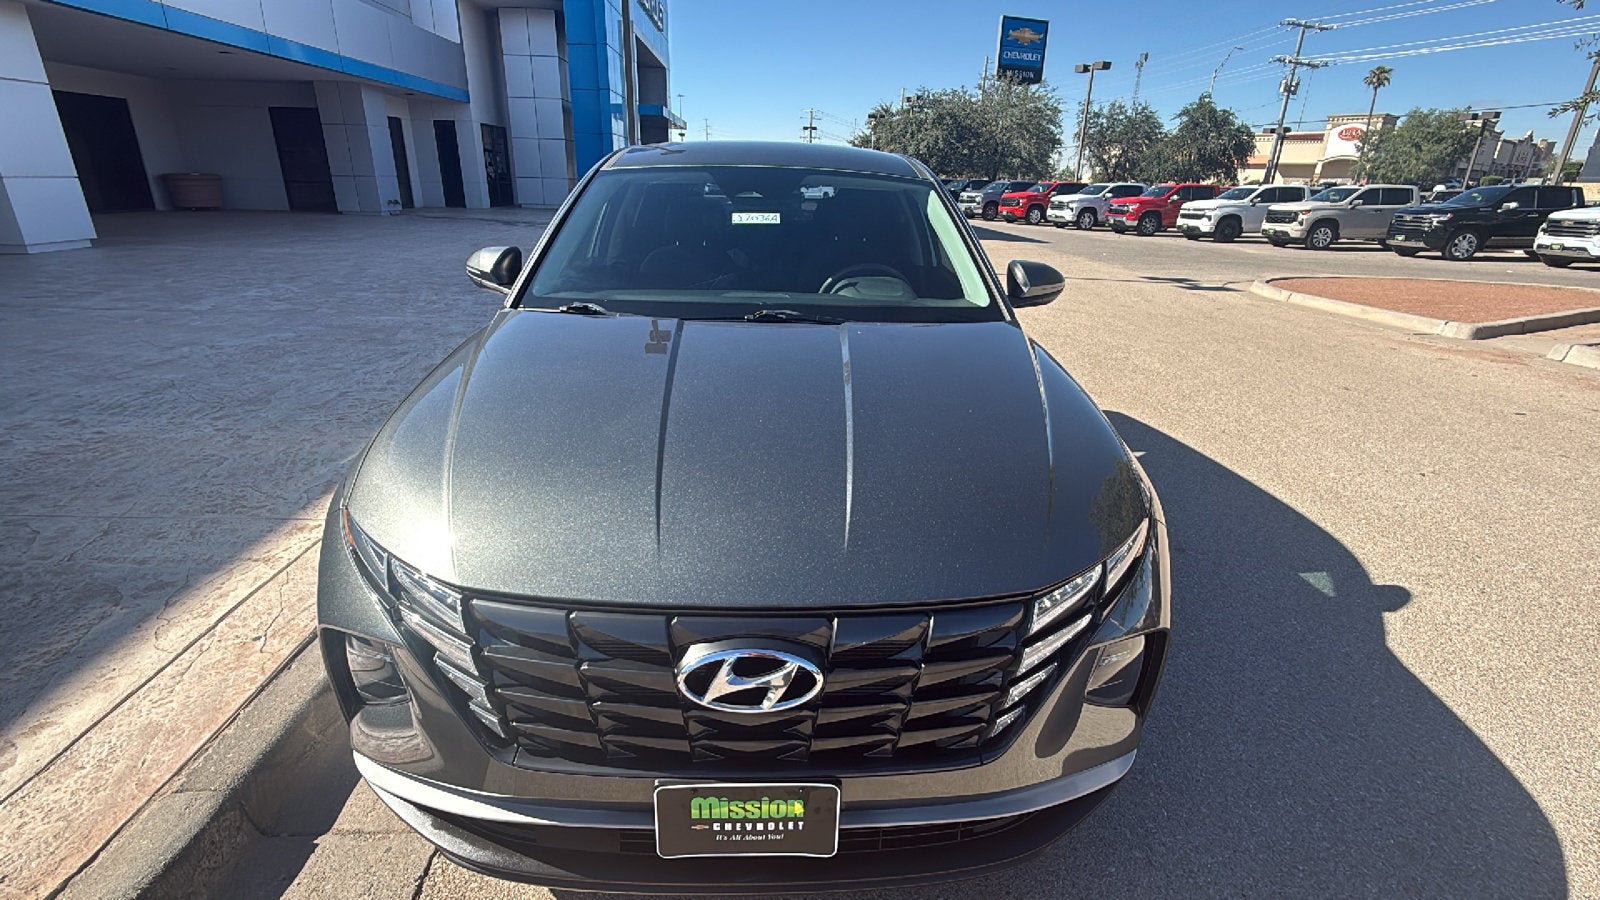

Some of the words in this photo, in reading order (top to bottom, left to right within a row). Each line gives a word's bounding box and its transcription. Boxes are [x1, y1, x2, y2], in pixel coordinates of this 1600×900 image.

[1003, 51, 1041, 61] CHEVROLET
[690, 796, 805, 819] Mission
[712, 821, 804, 831] CHEVROLET
[743, 833, 766, 841] About
